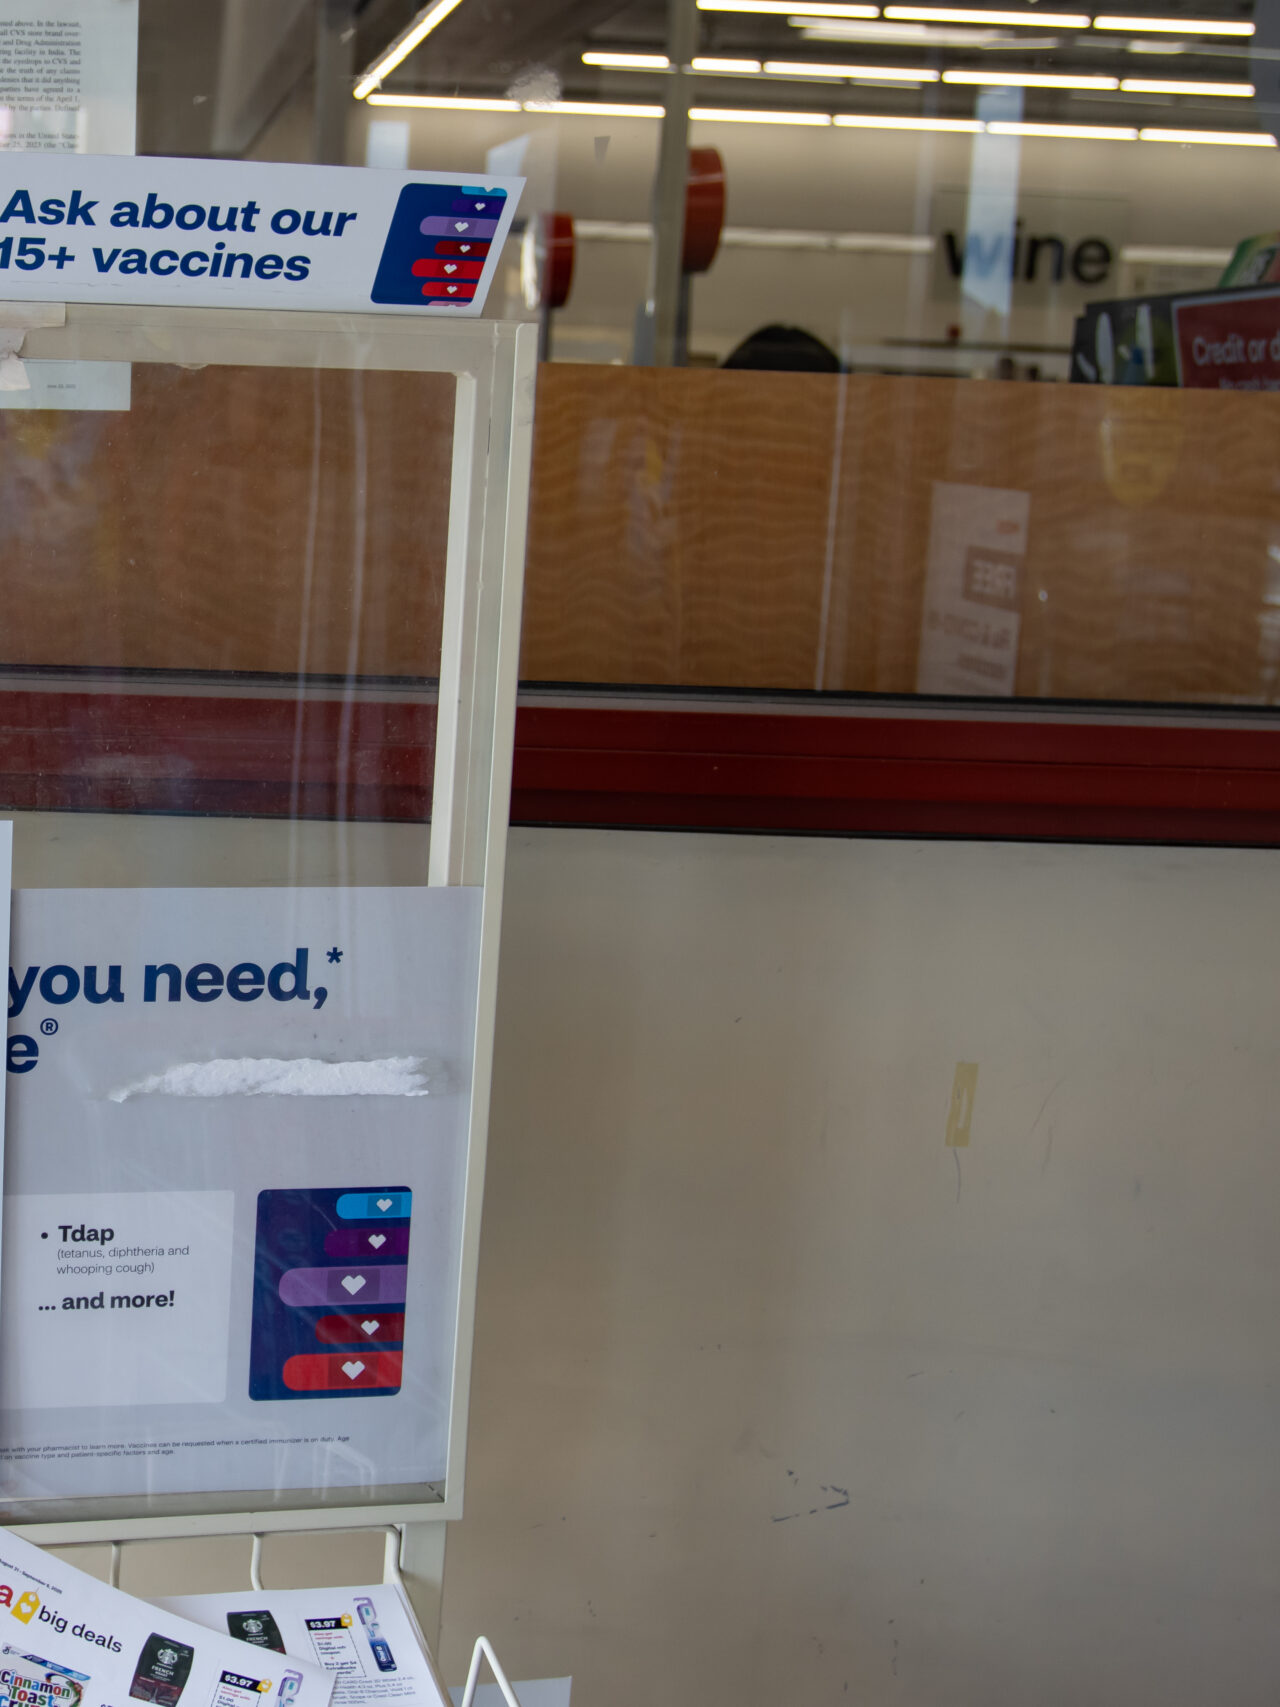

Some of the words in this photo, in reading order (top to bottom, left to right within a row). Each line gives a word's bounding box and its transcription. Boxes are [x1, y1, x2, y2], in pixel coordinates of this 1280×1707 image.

[109, 192, 260, 232] about
[270, 208, 358, 237] our
[92, 241, 312, 281] vaccines
[942, 216, 1112, 285] wine
[1192, 332, 1246, 366] Credit
[1248, 338, 1267, 363] or
[8, 963, 125, 1018] you
[58, 1224, 114, 1246] Tdap
[57, 1248, 106, 1260] (tetanus,
[108, 1246, 165, 1259] diphtheria
[168, 1245, 190, 1256] and
[56, 1264, 113, 1276] whooping
[115, 1262, 155, 1275] cough)
[61, 1291, 105, 1311] and
[110, 1290, 175, 1309] more!
[27, 1446, 42, 1454] your
[42, 1444, 80, 1454] pharmacist
[181, 1440, 215, 1449] requested
[240, 1438, 268, 1446] certified
[337, 1435, 350, 1443] Age
[41, 1453, 56, 1461] type
[38, 1605, 69, 1633] big
[74, 1622, 124, 1653] deals
[309, 1620, 336, 1629] $3.97
[1, 1670, 70, 1698] Cinnamon
[224, 1674, 253, 1688] $3.97
[10, 1686, 55, 1706] Toast
